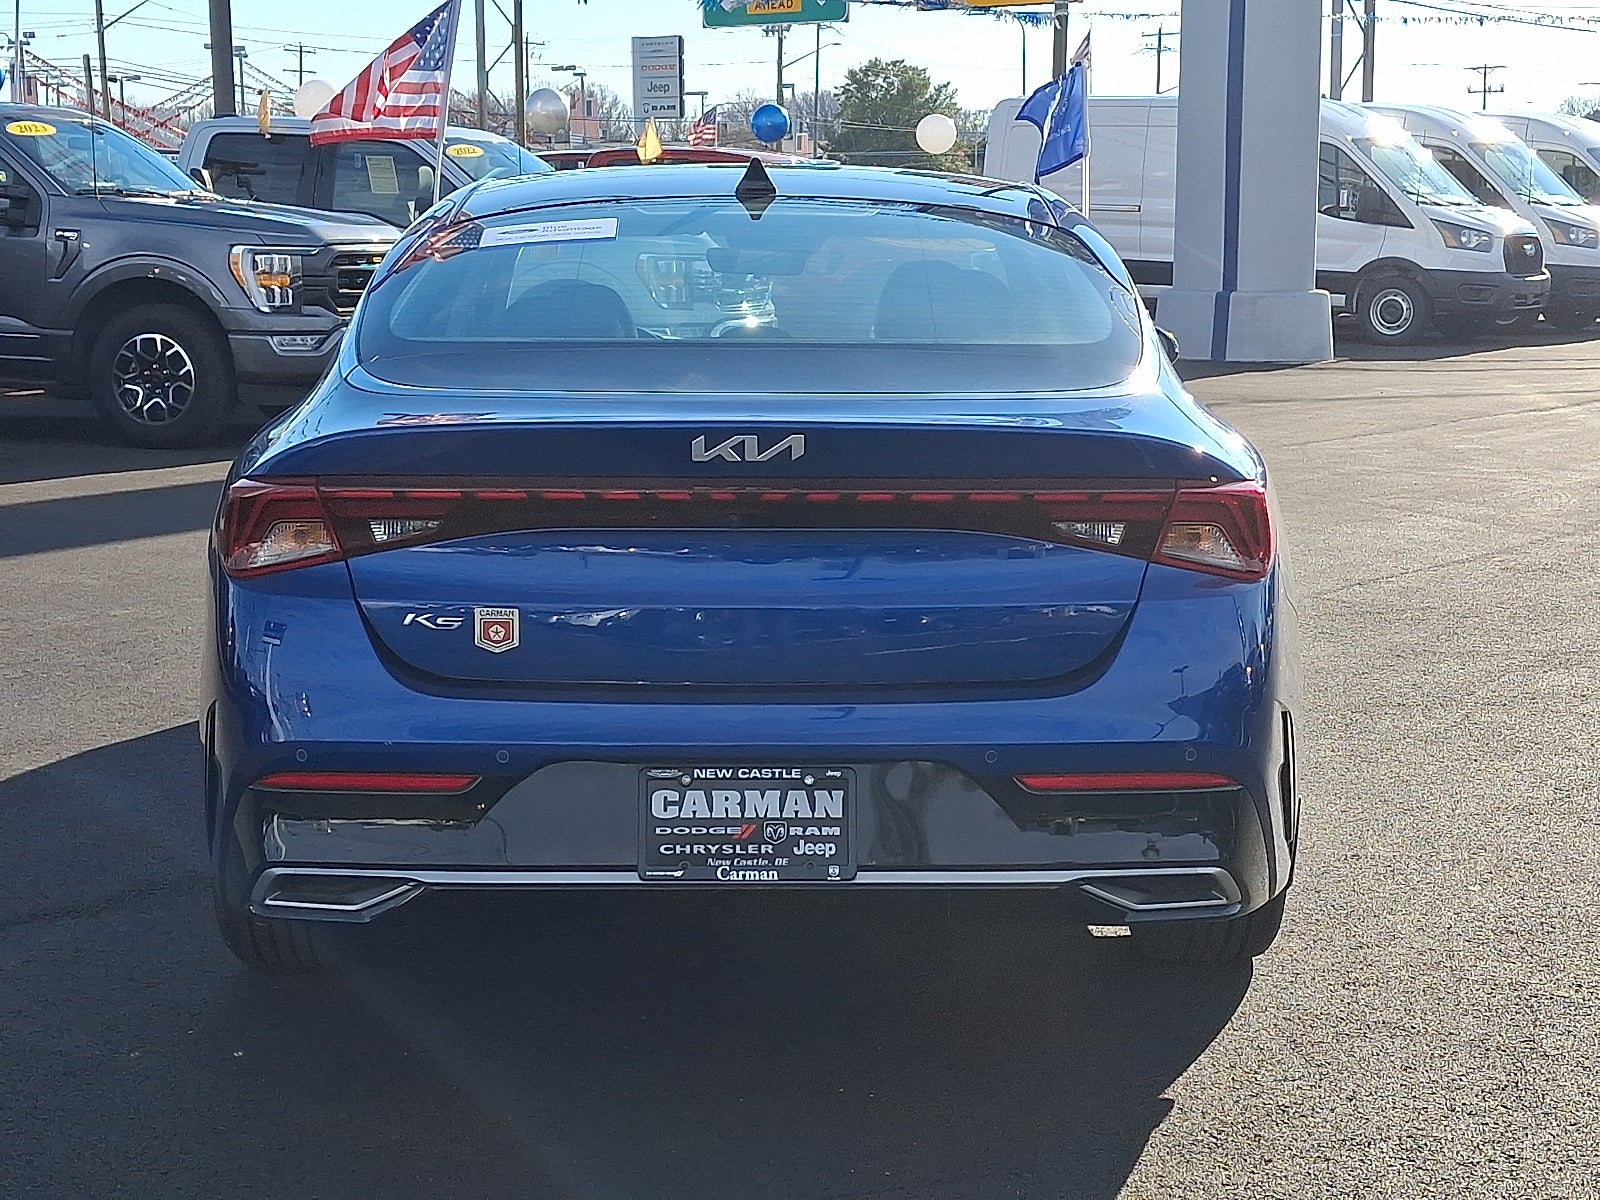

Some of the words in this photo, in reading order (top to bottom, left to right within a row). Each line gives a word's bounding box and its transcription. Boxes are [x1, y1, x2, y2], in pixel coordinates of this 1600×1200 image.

[641, 64, 677, 72] DODGE
[647, 81, 670, 94] Jeep
[691, 434, 805, 462] KIA
[479, 609, 515, 617] CARMAN
[693, 768, 733, 779] NEW
[738, 768, 802, 779] CASTLE
[651, 789, 845, 819] CARMAN
[655, 826, 743, 835] DODGE
[789, 826, 841, 836] RAM
[659, 844, 774, 855] CHRYSLER
[792, 839, 836, 858] Jeep
[774, 857, 790, 867] DE
[716, 866, 779, 881] Carman
